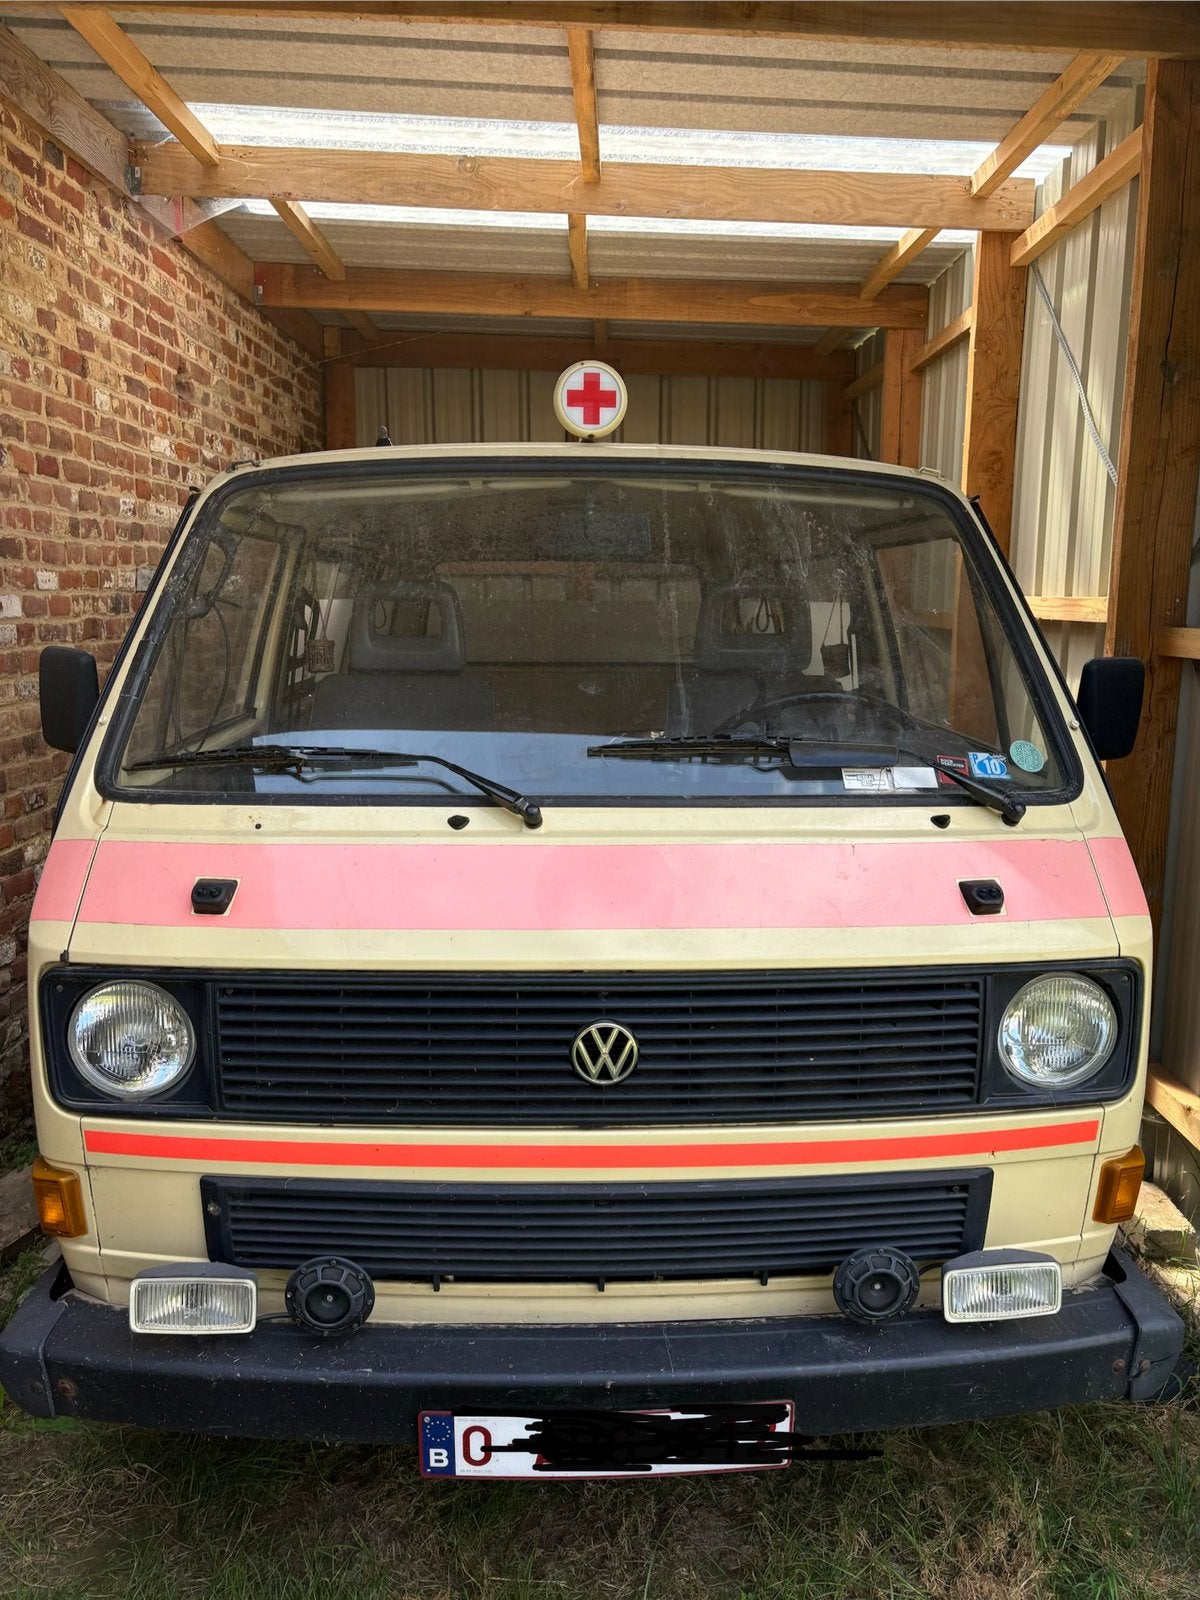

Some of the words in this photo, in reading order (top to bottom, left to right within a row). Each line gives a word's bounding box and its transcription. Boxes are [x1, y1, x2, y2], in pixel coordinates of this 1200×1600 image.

[983, 759, 1000, 775] 10
[575, 1026, 635, 1082] VW
[429, 1448, 449, 1468] B
